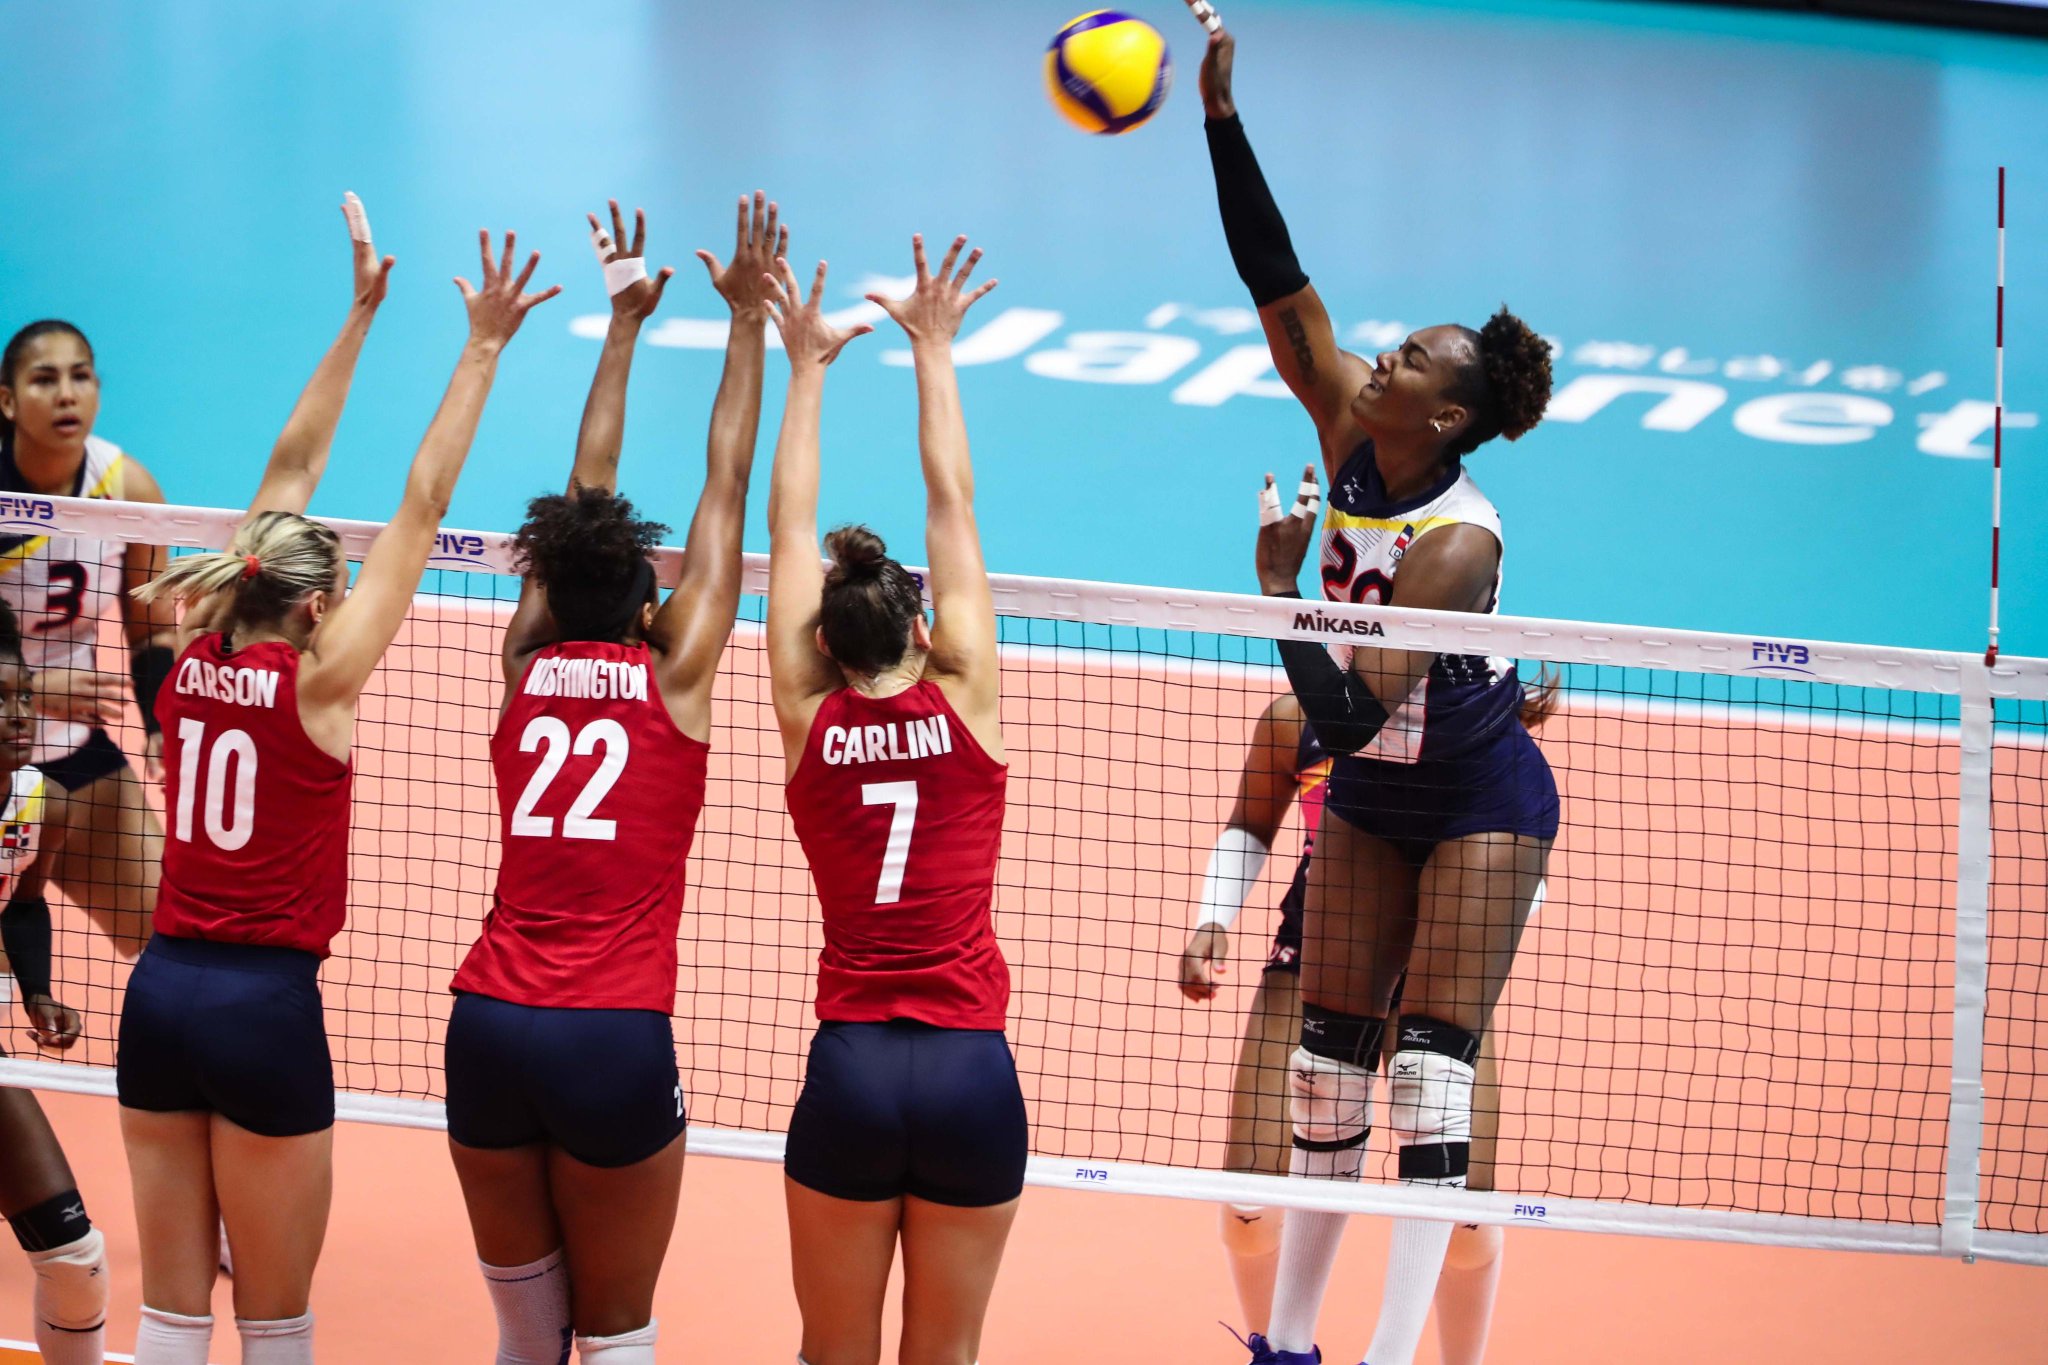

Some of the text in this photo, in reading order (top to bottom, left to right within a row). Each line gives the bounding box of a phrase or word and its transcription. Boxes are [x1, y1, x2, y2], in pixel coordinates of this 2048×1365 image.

[0, 498, 54, 520] FIVB
[33, 560, 88, 632] 3
[1293, 608, 1385, 637] MIKASA
[1752, 641, 1810, 665] FIVB
[175, 657, 280, 709] LARSON
[523, 656, 648, 702] WSHINGTON
[822, 714, 952, 765] CARLINI
[175, 717, 258, 851] 10
[511, 715, 630, 841] 22
[861, 780, 918, 904] 7
[1076, 1168, 1108, 1181] FIVB
[1514, 1204, 1546, 1218] FIVB
